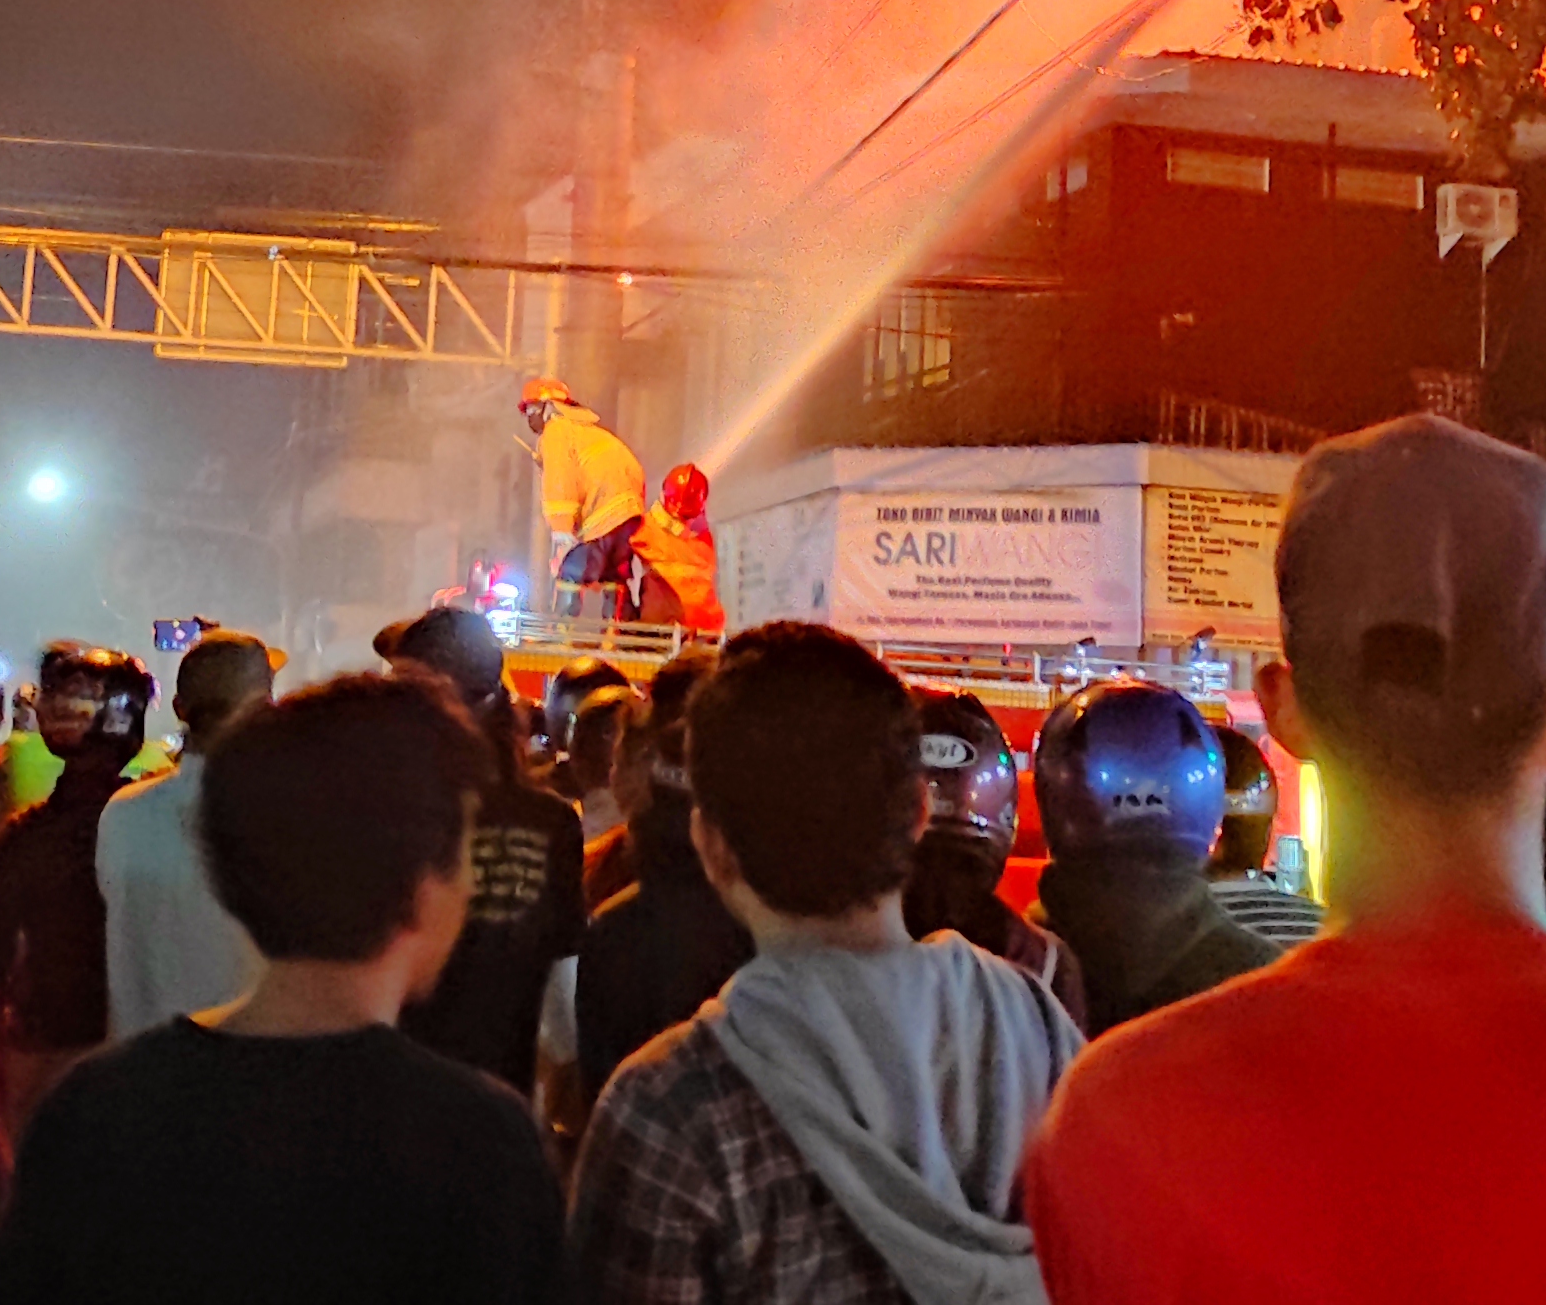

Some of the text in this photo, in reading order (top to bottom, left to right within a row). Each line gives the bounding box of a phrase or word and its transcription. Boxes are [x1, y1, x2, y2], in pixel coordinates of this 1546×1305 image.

[876, 507, 908, 523] TOKO
[948, 507, 998, 524] MINYAK
[1002, 508, 1044, 524] WANGI
[1060, 508, 1101, 524] KIMIA
[873, 531, 957, 567] SARI
